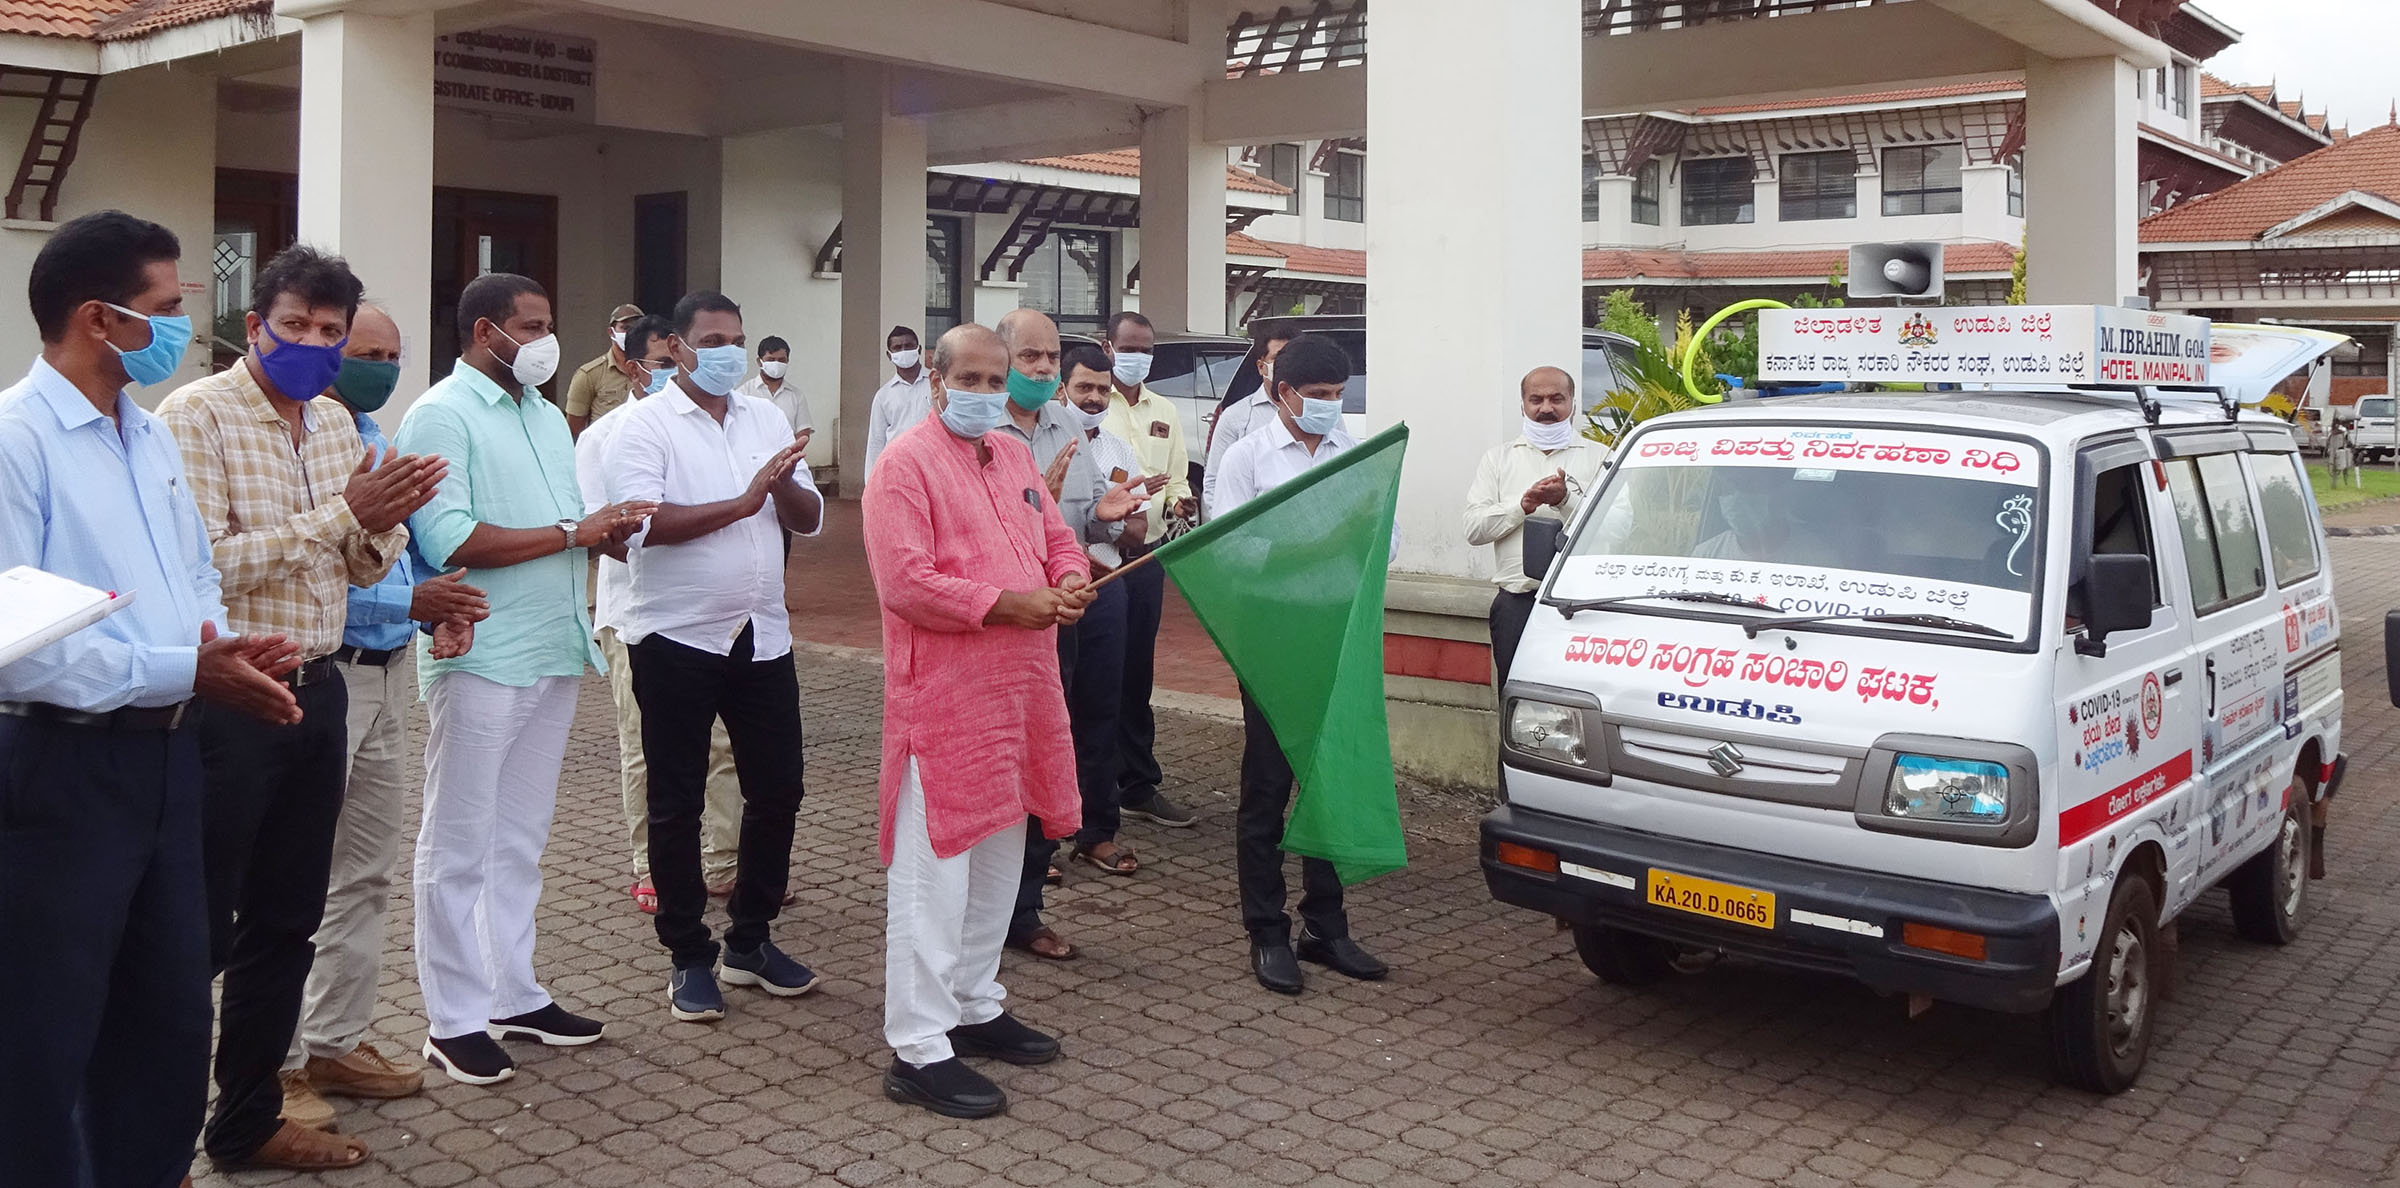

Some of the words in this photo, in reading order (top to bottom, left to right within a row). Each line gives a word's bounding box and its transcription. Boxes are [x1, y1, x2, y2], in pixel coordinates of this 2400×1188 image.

[443, 52, 532, 79] COMMISSIONER
[534, 64, 542, 79] &
[543, 65, 592, 87] DISTRICT
[1794, 316, 1882, 343] ಜಿಲ್ಲಾಡಳಿತ
[1954, 316, 2011, 333] ಉಡುಪಿ
[2021, 313, 2053, 341] ಜಿಲ್ಲೆ
[2185, 339, 2205, 358] GOA
[1766, 354, 1816, 372] ಕರ್ನಾಟಕ
[1822, 352, 1851, 378] ರಾಜ್ಯ
[1858, 353, 1899, 372] ಸರಕಾರಿ
[1906, 351, 1950, 372] ನೌಕರರ
[2003, 354, 2050, 373] ಉಡುಪಿ
[2059, 351, 2085, 381] ಜಿಲ್ಲೆ
[2101, 359, 2139, 380] HOTEL
[2143, 361, 2191, 381] MANIPAL
[1640, 440, 1701, 462] ರಾಜ್ಯ
[1710, 437, 1796, 461] ವಿಪತ್ತು
[1802, 438, 1951, 465] ನಿರ್ವಹಣಾ
[1960, 447, 2021, 475] ನಿಧಿ
[1595, 562, 1627, 581] ಜಿಲ್ಲಾ
[1632, 562, 1689, 584] ಆರೋಗ್ಯ
[1695, 569, 1725, 584] ಮತ್ತು
[1839, 579, 1918, 600] ಉಡುಪಿ
[1927, 590, 1970, 612] ಜಿಲ್ಲೆ
[1779, 597, 1886, 618] COVID-19
[1564, 634, 1648, 668] ಮಾದರಿ
[1649, 642, 1741, 688] ಸಂಗ್ರಹ
[1741, 653, 1849, 692] ಸಂಚಾರಿ
[1657, 691, 1802, 725] ಉಡುಪಿ
[2081, 689, 2121, 721] COVID-19
[1655, 884, 1767, 923] KA.20.D.0665
